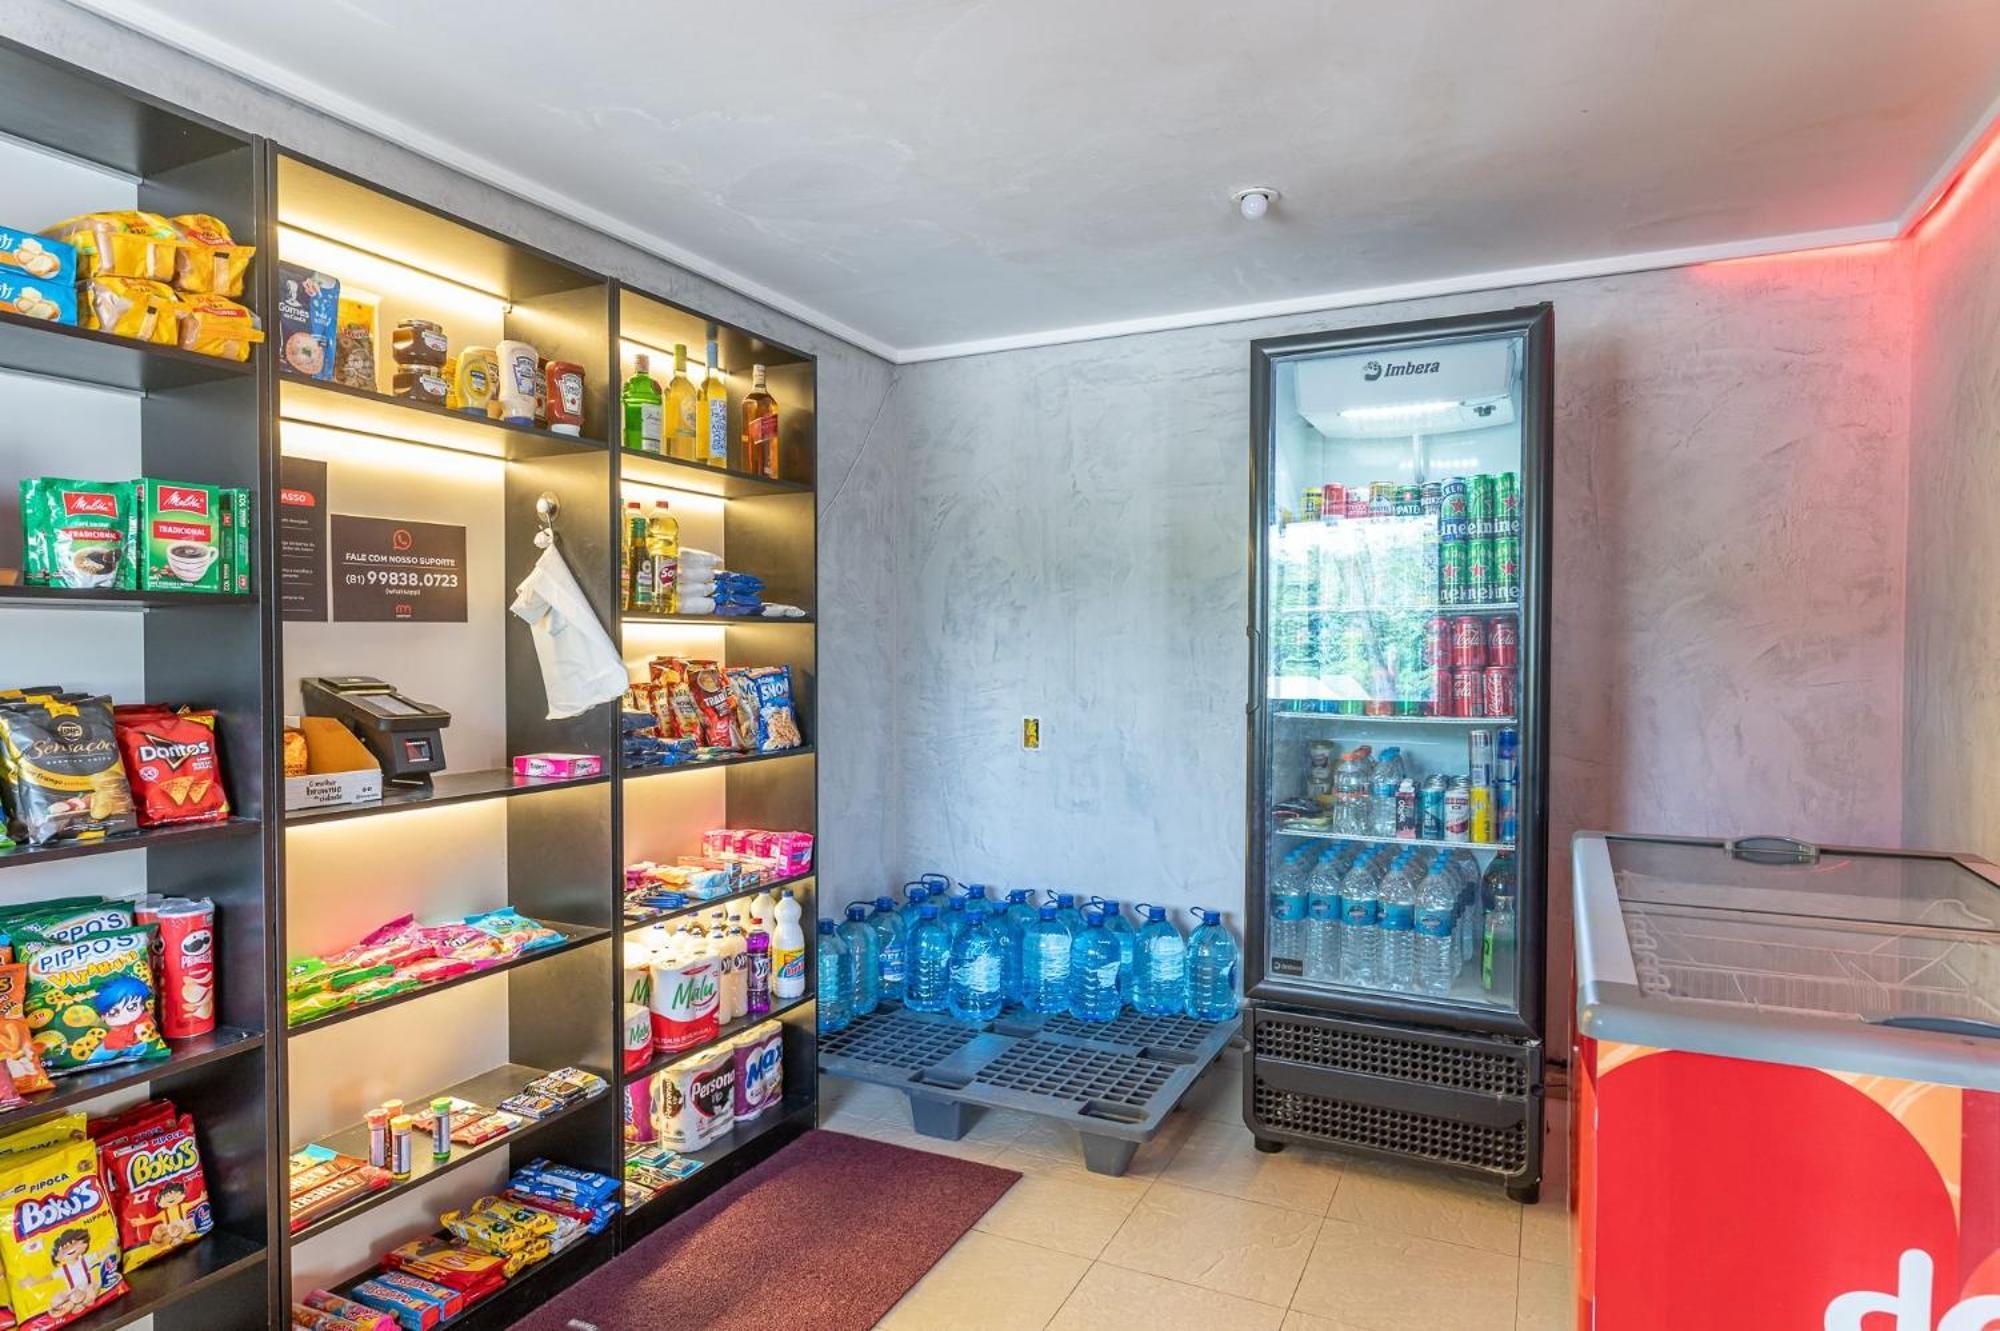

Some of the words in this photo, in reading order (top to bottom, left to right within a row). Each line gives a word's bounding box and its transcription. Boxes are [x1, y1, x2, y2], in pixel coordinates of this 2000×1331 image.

[1384, 361, 1440, 378] Imbera
[281, 491, 306, 502] ASSO
[159, 525, 206, 536] TRADICIONAL
[345, 552, 366, 561] FALE
[368, 554, 388, 562] COM
[389, 555, 418, 564] NOSSO
[420, 557, 456, 567] SUPORTE
[346, 574, 365, 585] (81)
[367, 570, 459, 588] 99838.0723
[140, 741, 209, 763] Doritos
[671, 974, 714, 1010] Malu
[691, 1068, 736, 1103] Persona
[30, 1172, 70, 1193] PIPOCA
